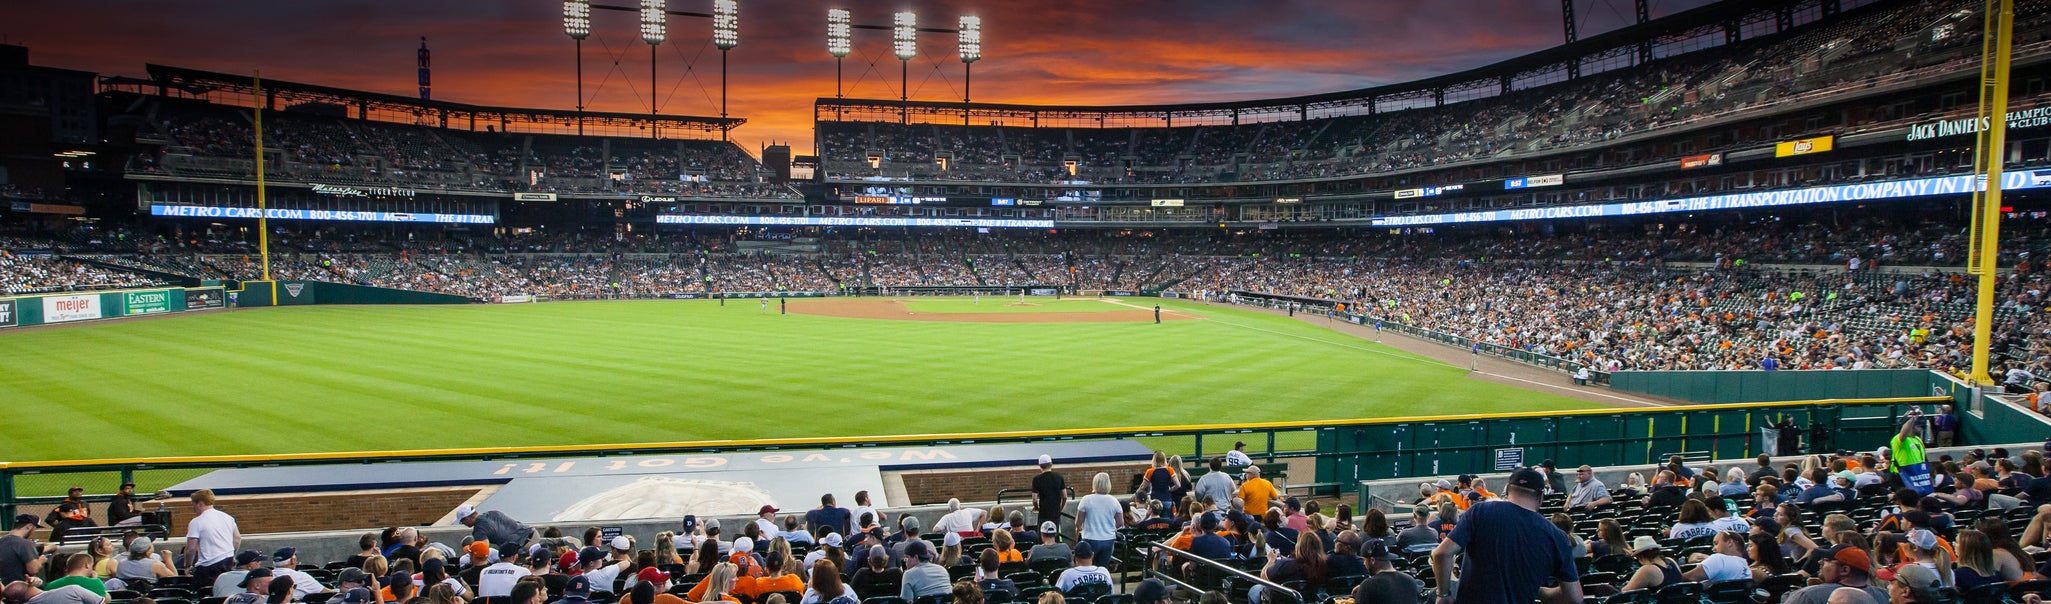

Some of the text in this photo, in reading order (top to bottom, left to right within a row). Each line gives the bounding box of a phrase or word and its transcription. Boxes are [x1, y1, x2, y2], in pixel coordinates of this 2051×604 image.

[2004, 106, 2051, 121] HAMPIO
[2017, 116, 2048, 128] CLUB
[1907, 122, 1935, 141] JACK
[397, 189, 415, 197] CLUB
[1406, 213, 1442, 225] CARS.COM
[1510, 208, 1542, 220] METRO
[1543, 203, 1602, 219] CARS.COM
[1687, 196, 1709, 211] THE
[1710, 195, 1722, 209] #1
[1723, 186, 1840, 208] TRANSPORTATION
[1843, 179, 1931, 201] COMPANY
[1933, 177, 1959, 195] IN
[2007, 171, 2027, 189] D
[162, 205, 222, 217] METRO
[225, 206, 303, 219] CARS.COM
[309, 210, 377, 221] 800-456-1701
[434, 213, 454, 223] THE
[456, 214, 467, 223] #1
[694, 215, 750, 225] CARS.COM
[759, 216, 809, 226] 800-456-1701
[818, 217, 853, 226] METRO
[856, 218, 907, 227] CARS.COM
[977, 219, 994, 228] THE
[56, 296, 89, 312] meijer
[128, 293, 165, 304] EASTERN
[492, 449, 958, 475] We've Got It!
[1228, 457, 1239, 466] 99
